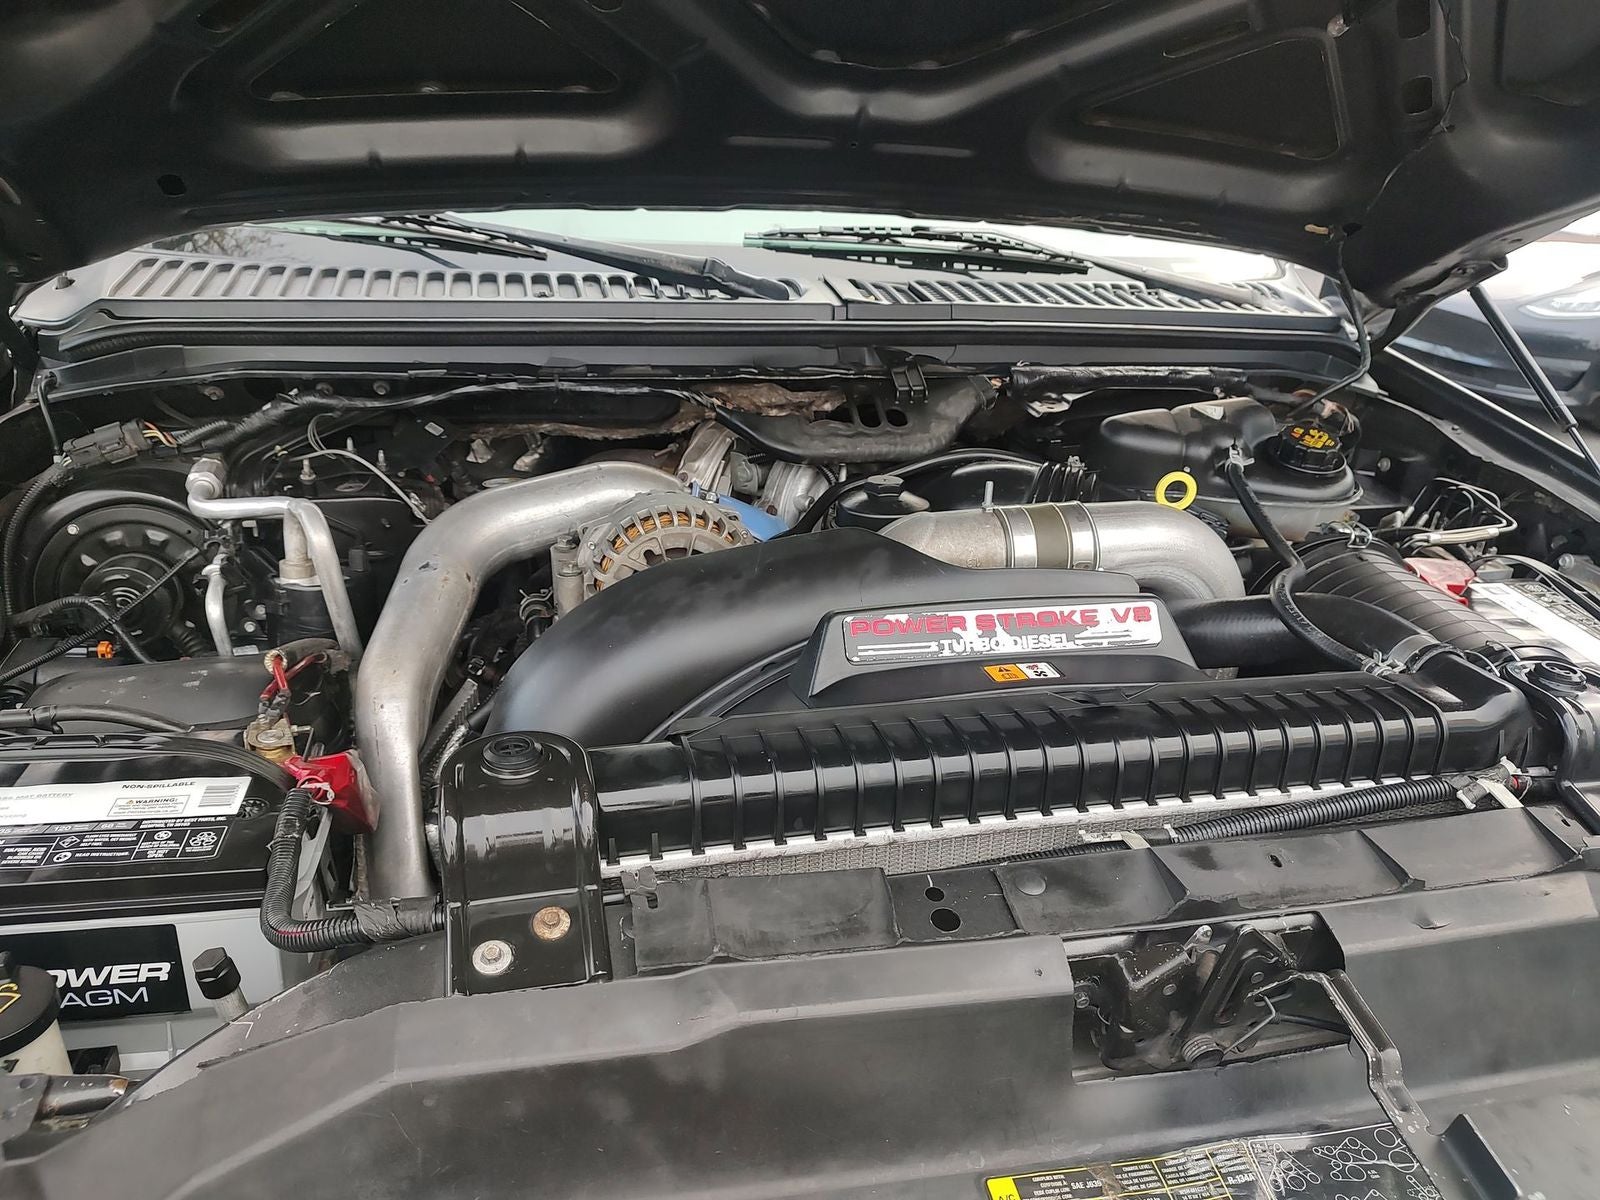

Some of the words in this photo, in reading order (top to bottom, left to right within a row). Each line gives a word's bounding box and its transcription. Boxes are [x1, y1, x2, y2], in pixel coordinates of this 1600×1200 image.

[850, 615, 967, 638] POWER
[975, 608, 1100, 631] STROKE
[1110, 605, 1152, 624] V8
[939, 637, 1008, 655] TURBO
[1009, 632, 1074, 650] DIESEL
[121, 781, 196, 789] NON-SPILLABLE
[46, 962, 171, 988] OWER
[60, 986, 149, 1009] AGM
[1070, 1182, 1085, 1190] SAE
[1227, 1172, 1256, 1185] R-134A
